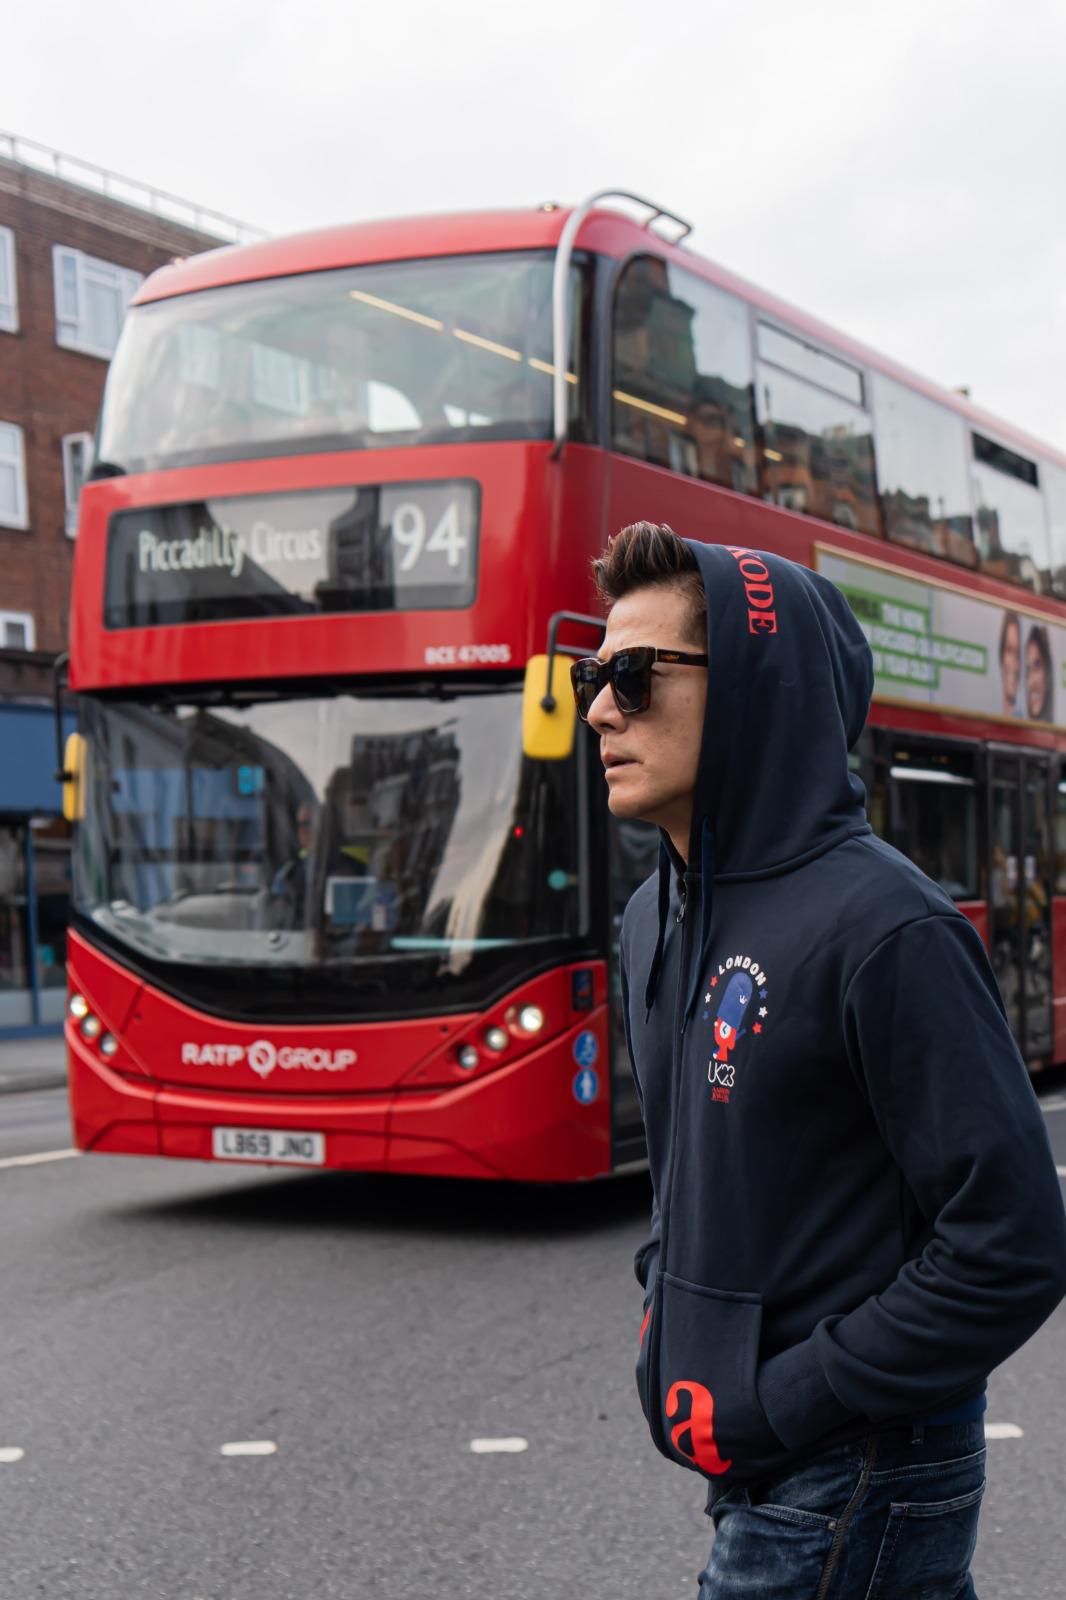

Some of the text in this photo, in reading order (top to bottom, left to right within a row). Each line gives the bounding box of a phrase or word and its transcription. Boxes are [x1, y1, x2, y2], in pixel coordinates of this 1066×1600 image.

[138, 520, 322, 577] Piccadilly Circus
[391, 501, 467, 570] 94
[718, 955, 768, 986] LONDON
[181, 1042, 358, 1072] RATP GROUP
[707, 1061, 736, 1087] UK23
[665, 1380, 732, 1475] a
